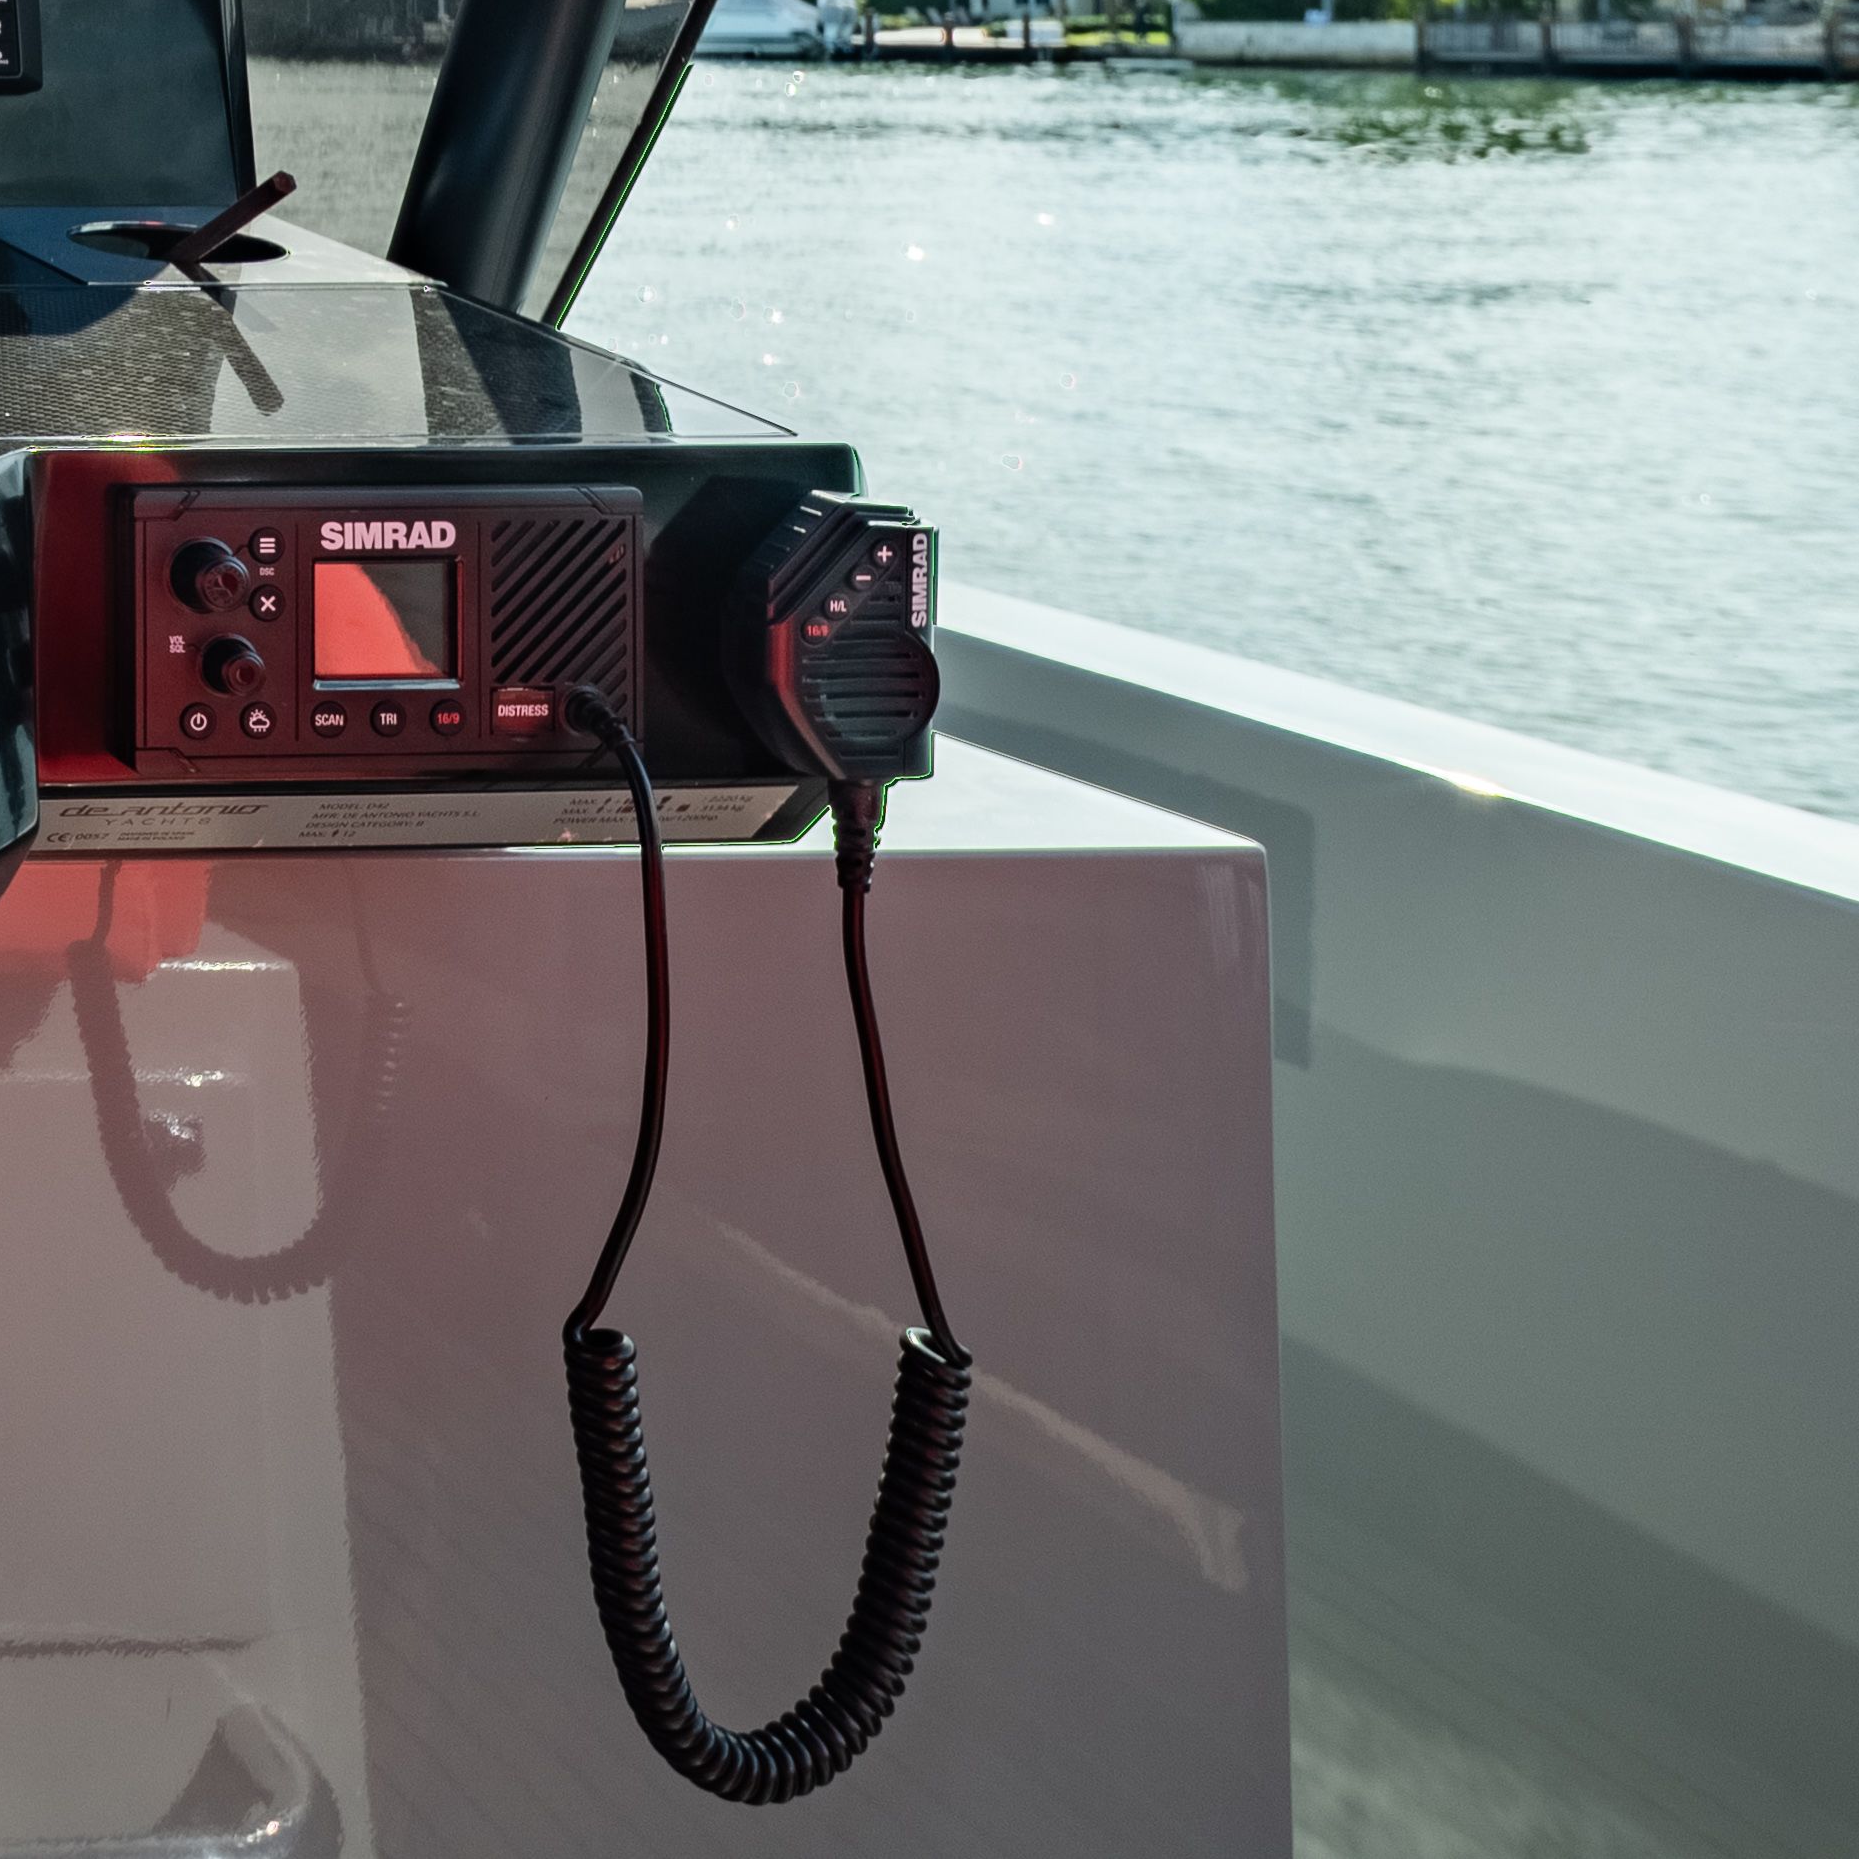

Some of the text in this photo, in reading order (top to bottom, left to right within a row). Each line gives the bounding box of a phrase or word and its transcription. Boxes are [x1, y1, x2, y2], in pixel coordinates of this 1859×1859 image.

[320, 521, 456, 550] SIMRAD
[259, 567, 275, 576] DSC
[911, 533, 928, 628] SIMRAD
[830, 600, 847, 612] H/L
[168, 636, 185, 644] VOL
[497, 704, 549, 717] DISTRESS
[315, 714, 344, 726] SCAN
[380, 713, 397, 725] TRI
[437, 712, 460, 724] 16/9
[104, 817, 212, 826] YACHTS
